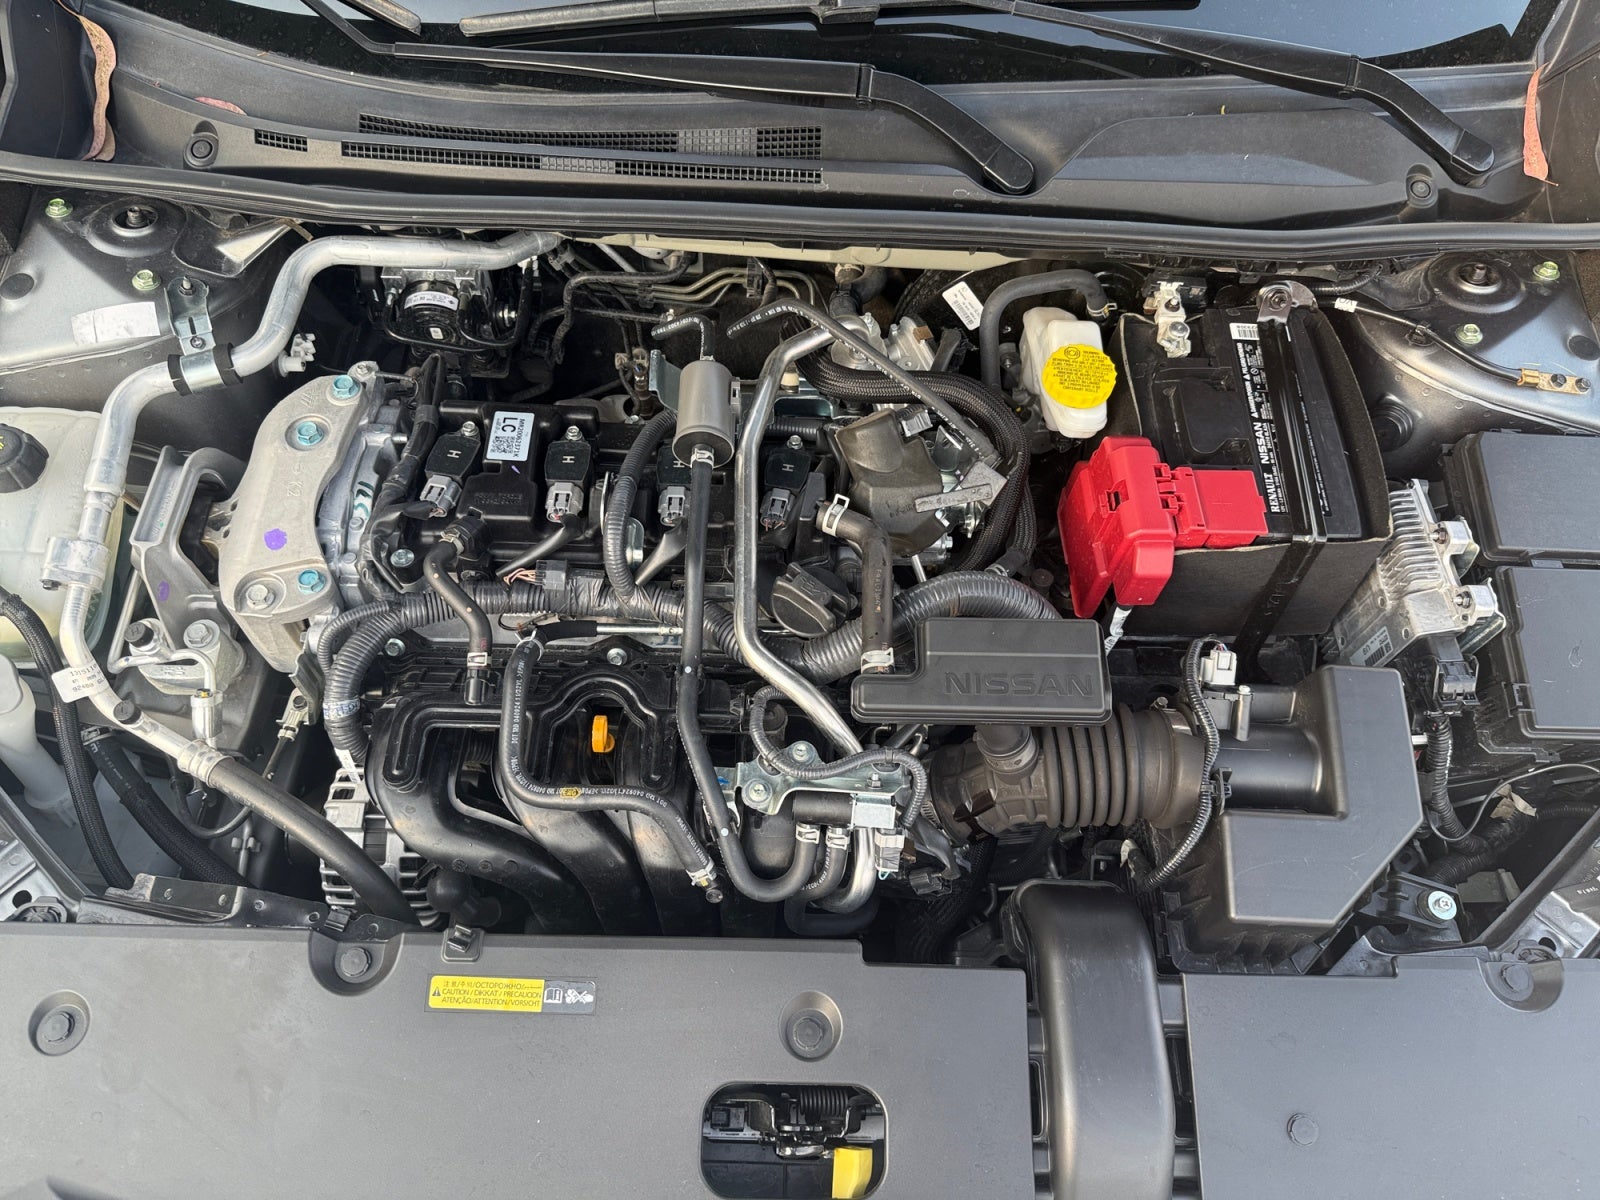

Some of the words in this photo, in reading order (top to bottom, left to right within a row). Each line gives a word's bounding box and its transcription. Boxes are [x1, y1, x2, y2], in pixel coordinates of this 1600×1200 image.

[502, 417, 518, 432] LC
[1253, 422, 1270, 464] NISSAN
[447, 450, 461, 458] H
[782, 464, 794, 472] H
[1264, 473, 1280, 513] RENAULT
[944, 672, 1092, 696] NISSAN
